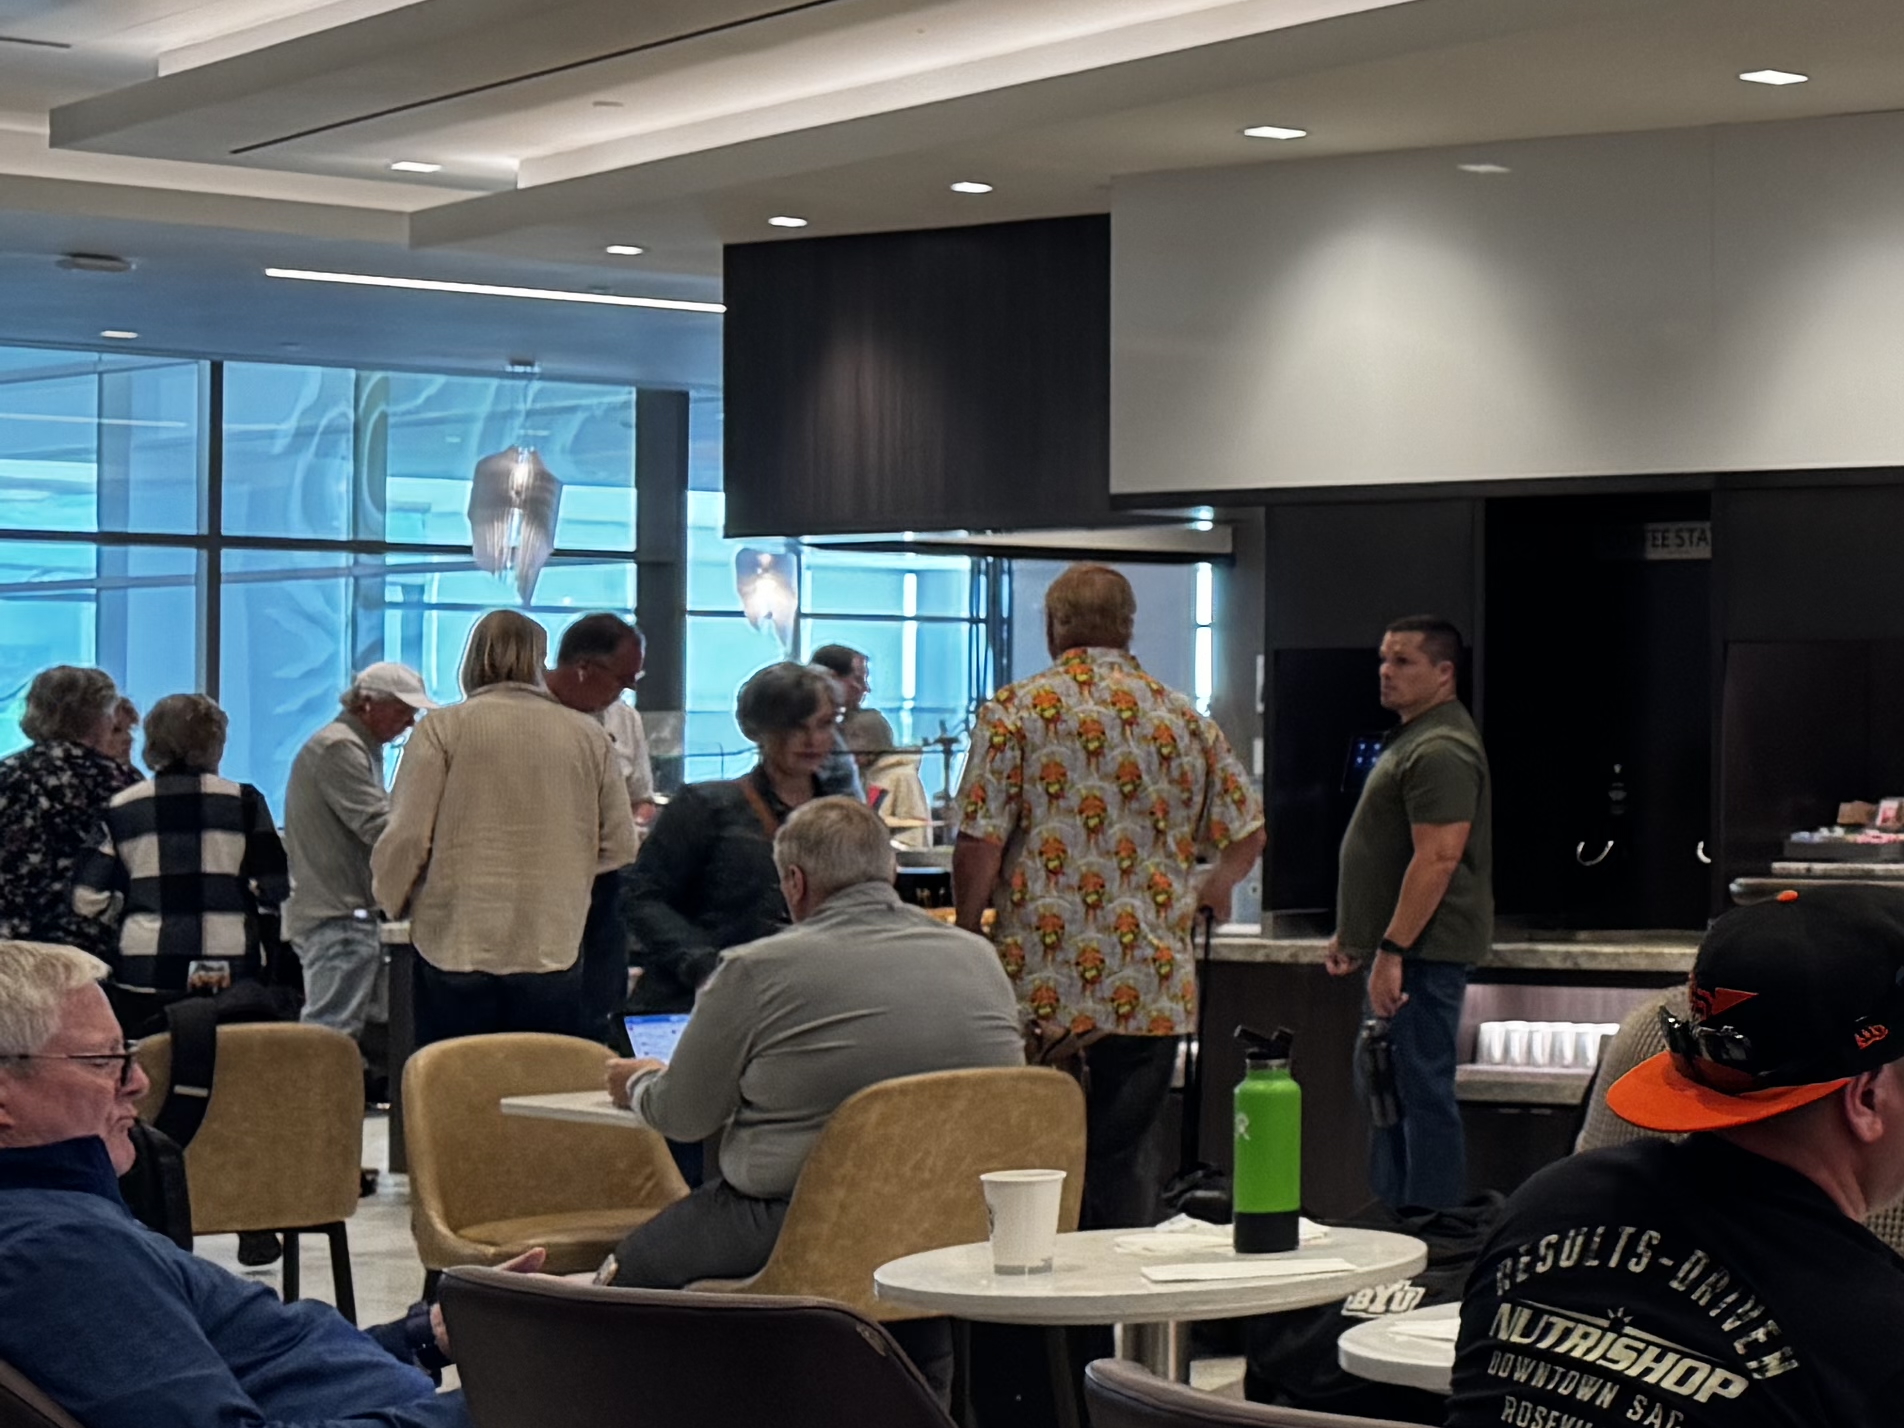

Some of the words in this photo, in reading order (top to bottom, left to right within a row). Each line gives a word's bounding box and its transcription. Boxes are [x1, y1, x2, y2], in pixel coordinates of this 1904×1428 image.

[1489, 1302, 1749, 1403] NUTRISHOP
[1496, 1225, 1799, 1380] RESULTS-DRIVEN
[1487, 1350, 1620, 1409] DOWNTOWN
